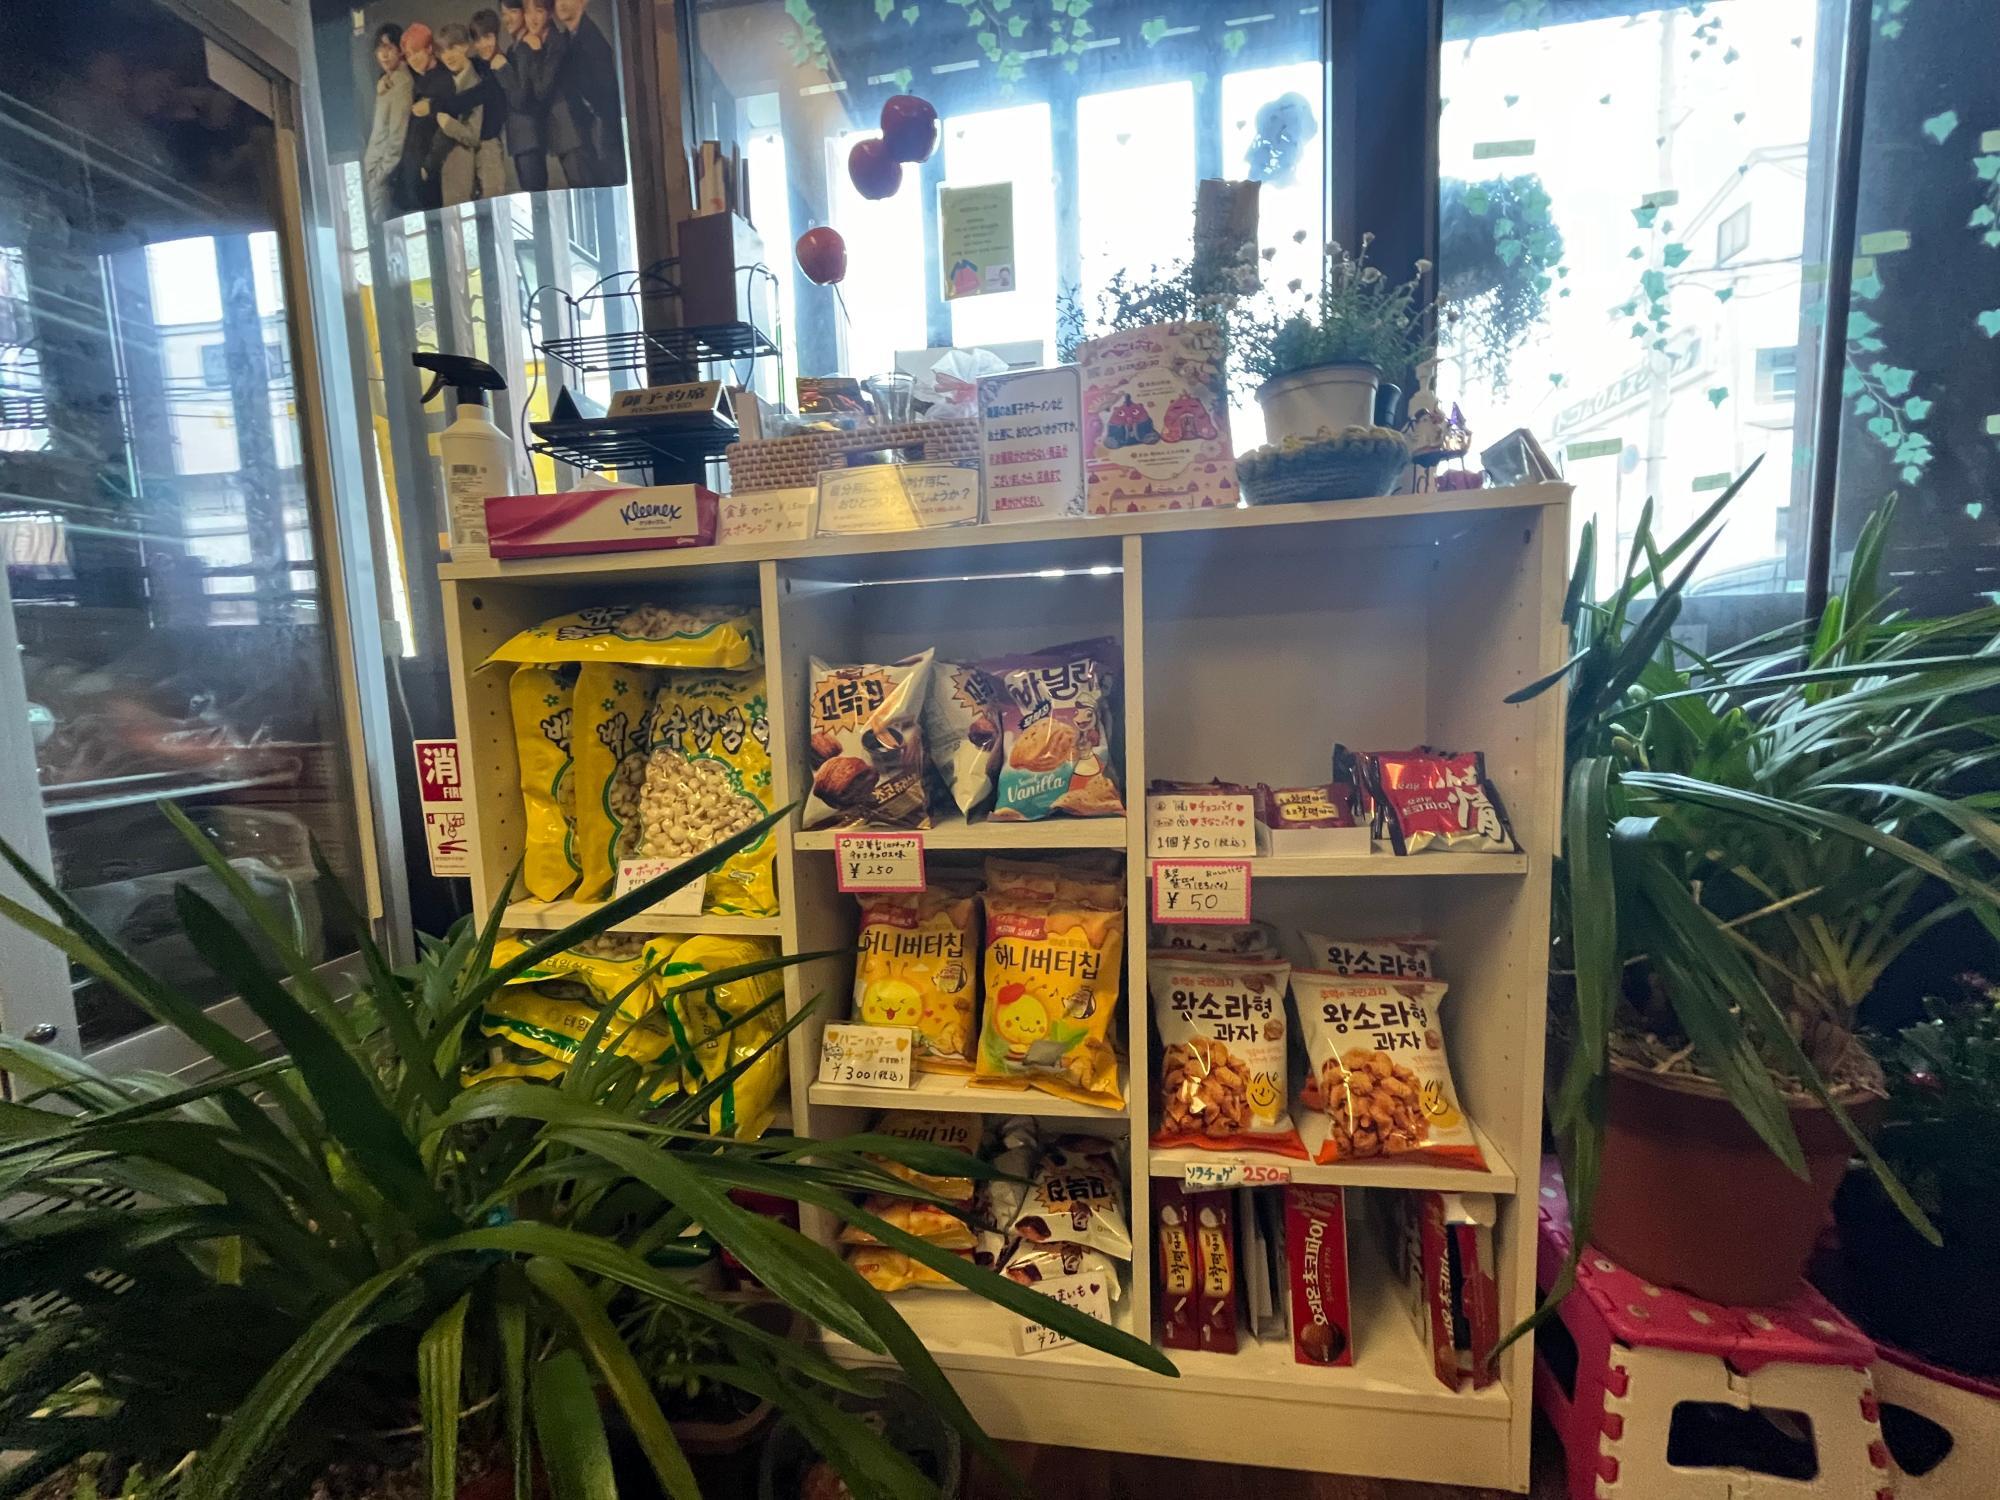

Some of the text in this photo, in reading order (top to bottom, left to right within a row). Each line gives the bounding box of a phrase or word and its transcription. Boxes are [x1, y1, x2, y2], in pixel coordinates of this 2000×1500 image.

[620, 501, 682, 525] Kleenex
[818, 679, 885, 721] 꼬북칩
[442, 786, 461, 799] FIR
[1007, 774, 1065, 803] Vanilla
[866, 866, 894, 875] 250
[1191, 893, 1218, 911] 50
[862, 929, 965, 958] 허니버터칩
[994, 943, 1101, 980] 허니버터칩
[1171, 989, 1273, 1021] 왕소라형
[1322, 1000, 1429, 1034] 왕소라형
[1213, 1023, 1259, 1043] 과자
[1372, 1032, 1422, 1052] 과자
[1302, 1217, 1328, 1285] 초코파이
[1305, 1285, 1329, 1326] 오리온
